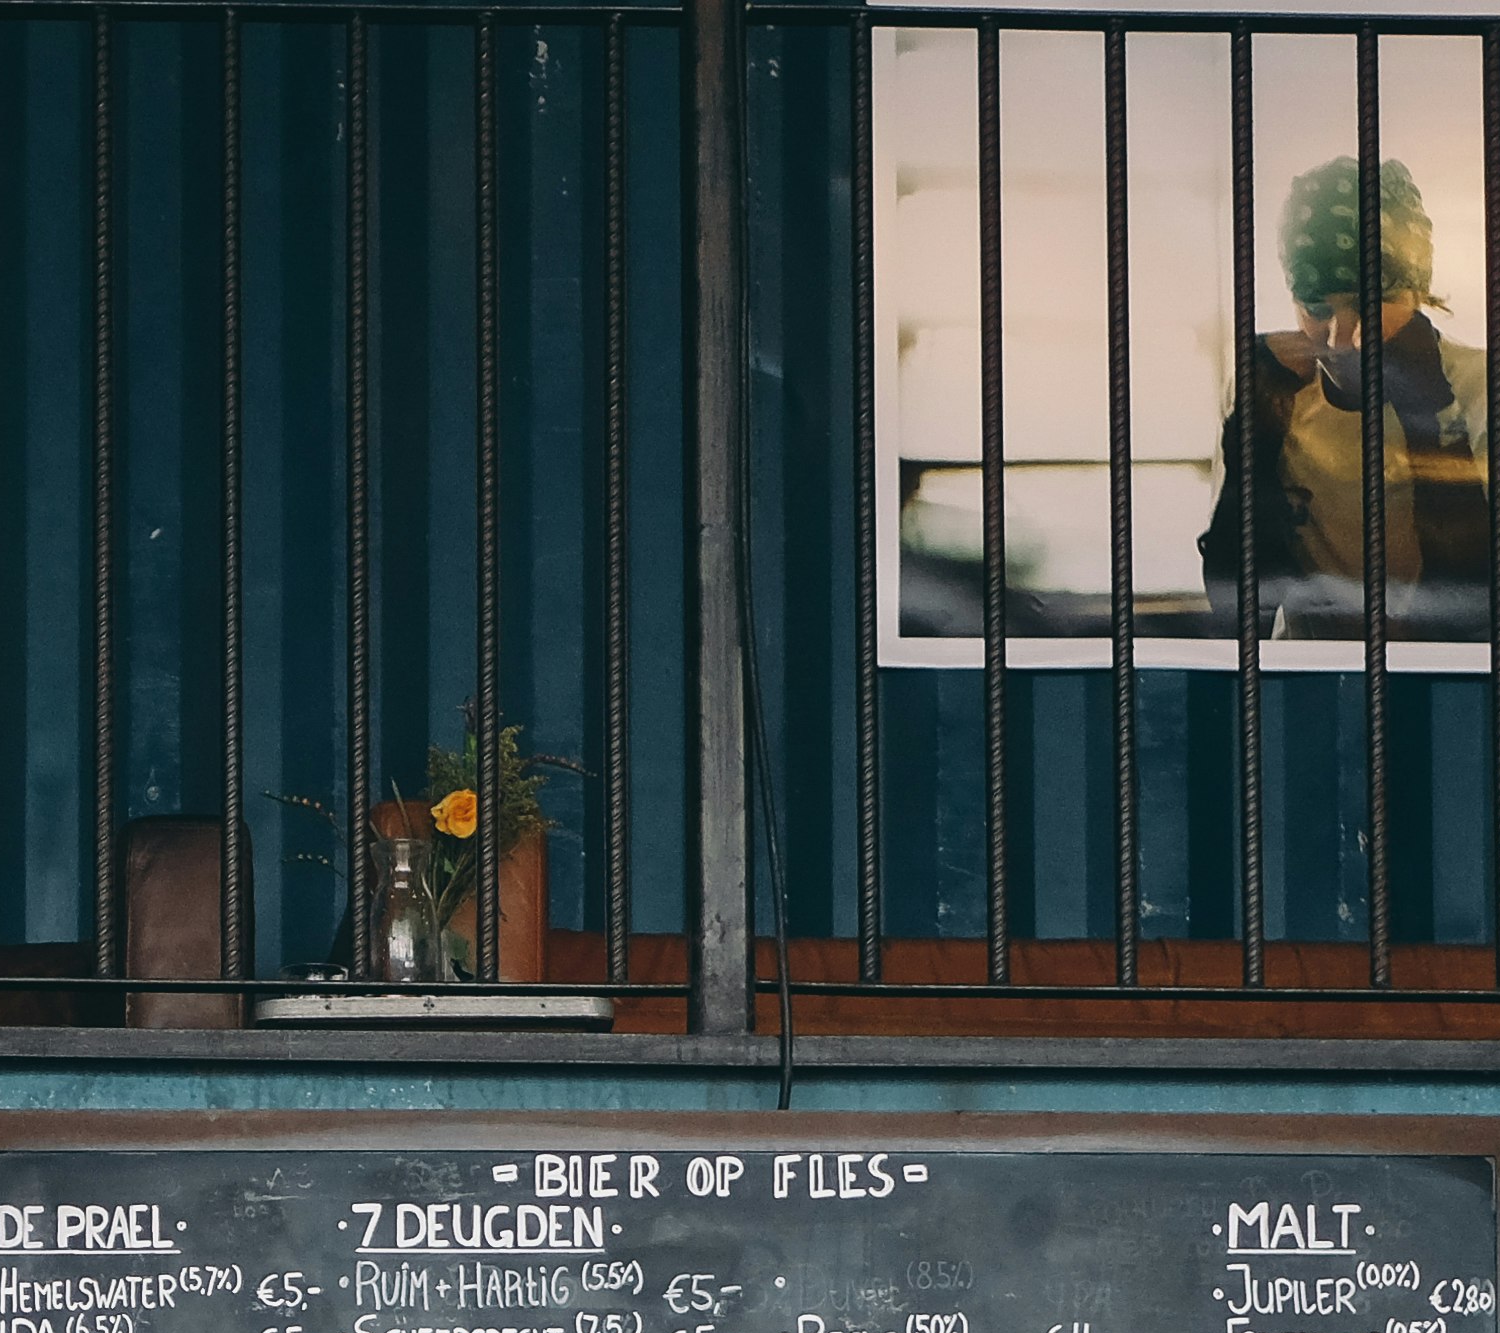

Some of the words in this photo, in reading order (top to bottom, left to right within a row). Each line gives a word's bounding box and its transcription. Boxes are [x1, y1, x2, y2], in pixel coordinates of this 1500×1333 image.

[535, 1153, 661, 1198] BIER
[685, 1154, 745, 1198] OP
[773, 1153, 896, 1199] FLES
[56, 1203, 175, 1250] PRAEL
[351, 1203, 383, 1248] 7
[396, 1202, 605, 1249] DEUGDEN
[1227, 1201, 1363, 1250] MALT
[0, 1266, 179, 1314] HEMELSWATER
[1226, 1262, 1358, 1316] JUPILER
